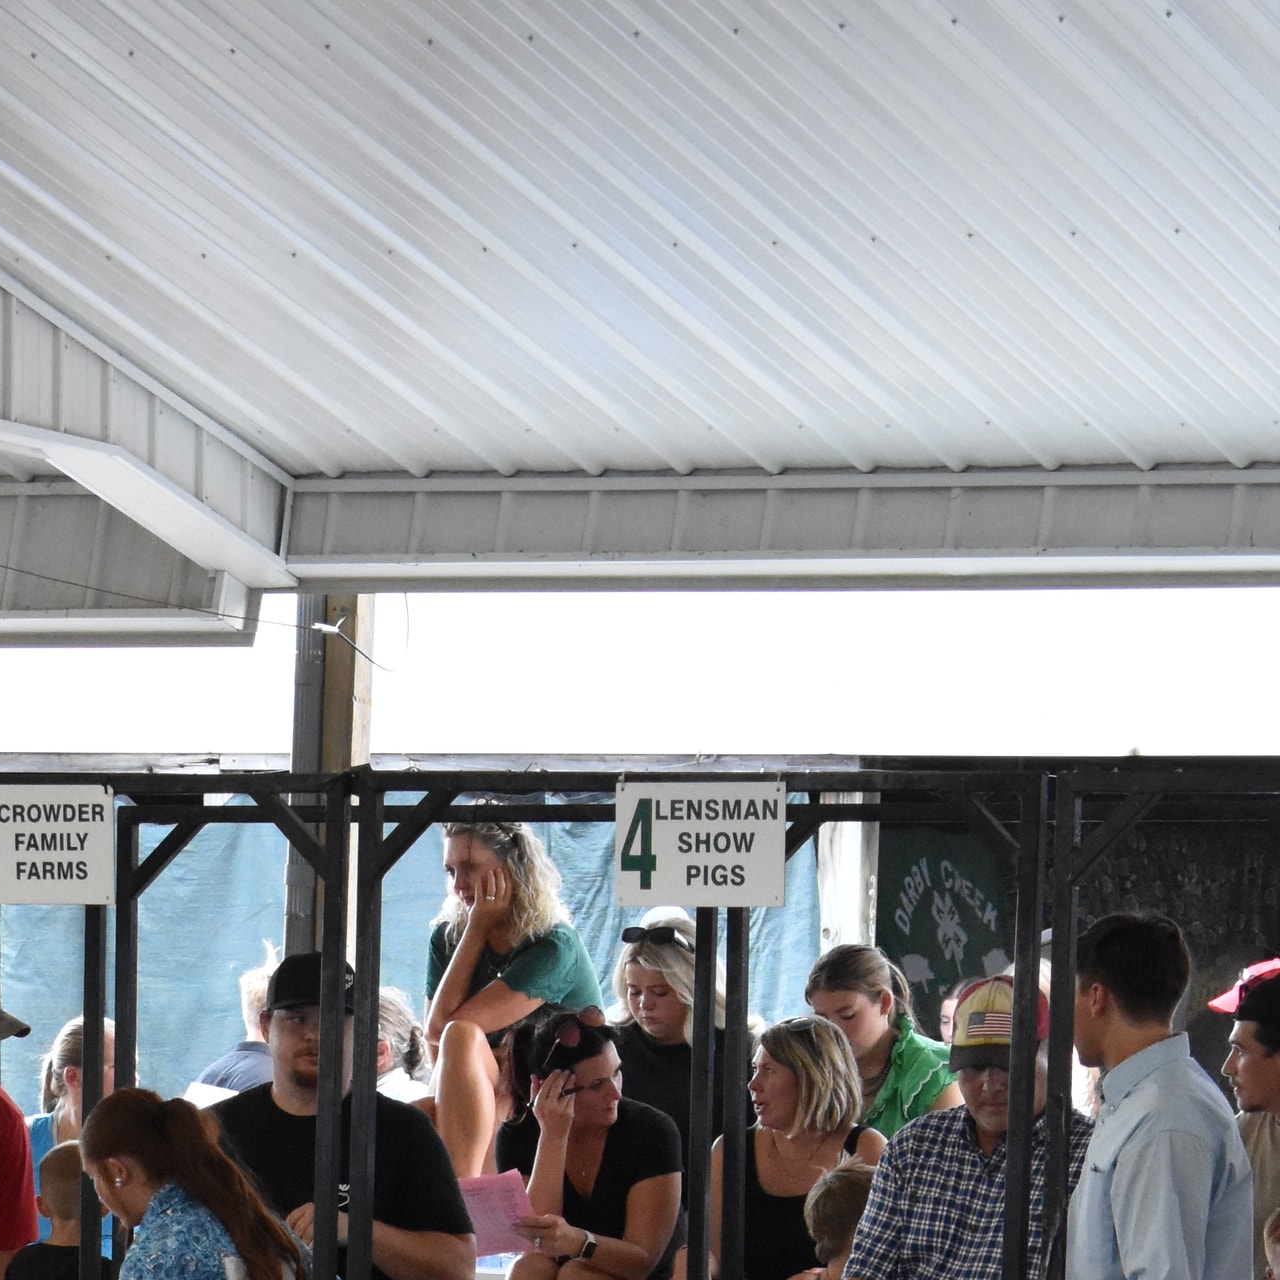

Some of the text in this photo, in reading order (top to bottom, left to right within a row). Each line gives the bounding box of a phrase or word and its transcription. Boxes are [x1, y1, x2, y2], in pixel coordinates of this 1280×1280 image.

[655, 799, 779, 821] LENSMAN
[14, 832, 89, 852] FAMILY
[620, 798, 657, 890] 4
[677, 831, 755, 854] SHOW
[16, 861, 89, 881] FARMS
[686, 864, 746, 887] PIGS
[894, 857, 998, 936] DARBY CREEK
